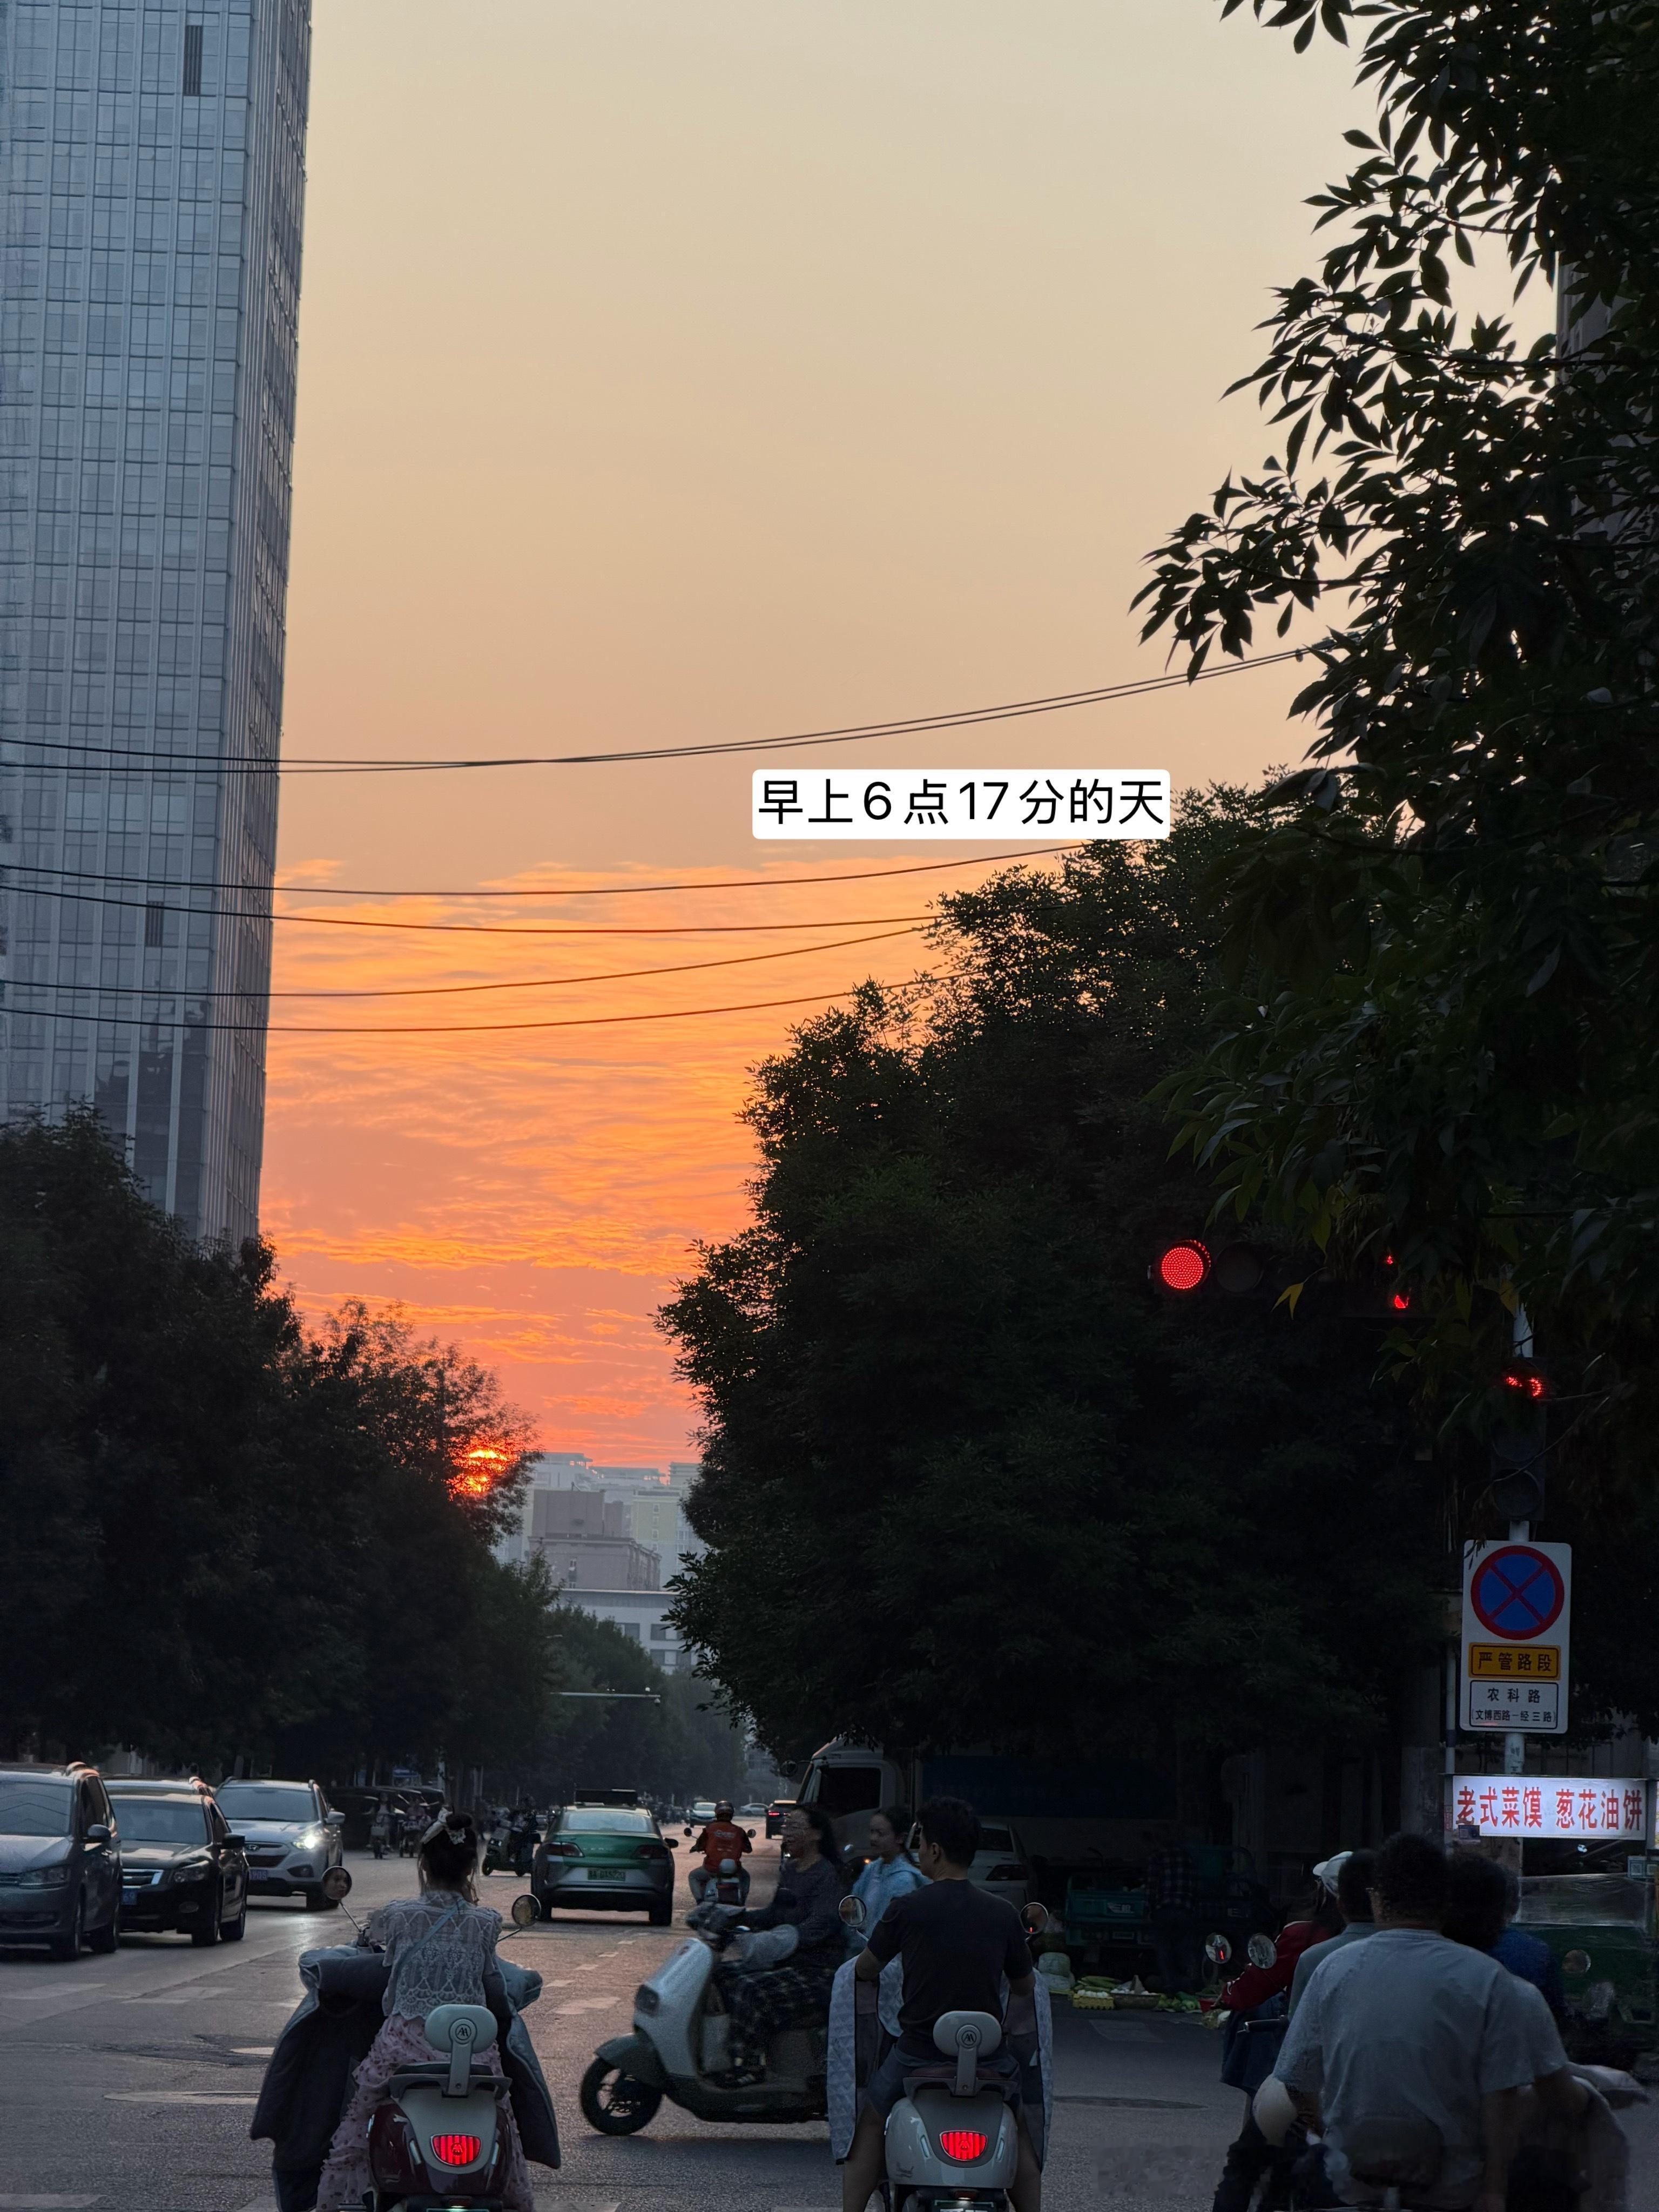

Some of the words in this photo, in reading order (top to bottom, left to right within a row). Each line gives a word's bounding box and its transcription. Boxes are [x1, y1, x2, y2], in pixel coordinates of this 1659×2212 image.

[1478, 1652, 1552, 1672] 严管路段
[1487, 1688, 1541, 1703] 农科路
[1455, 1785, 1542, 1829] 老式菜馍
[1555, 1788, 1642, 1831] 葱花油饼
